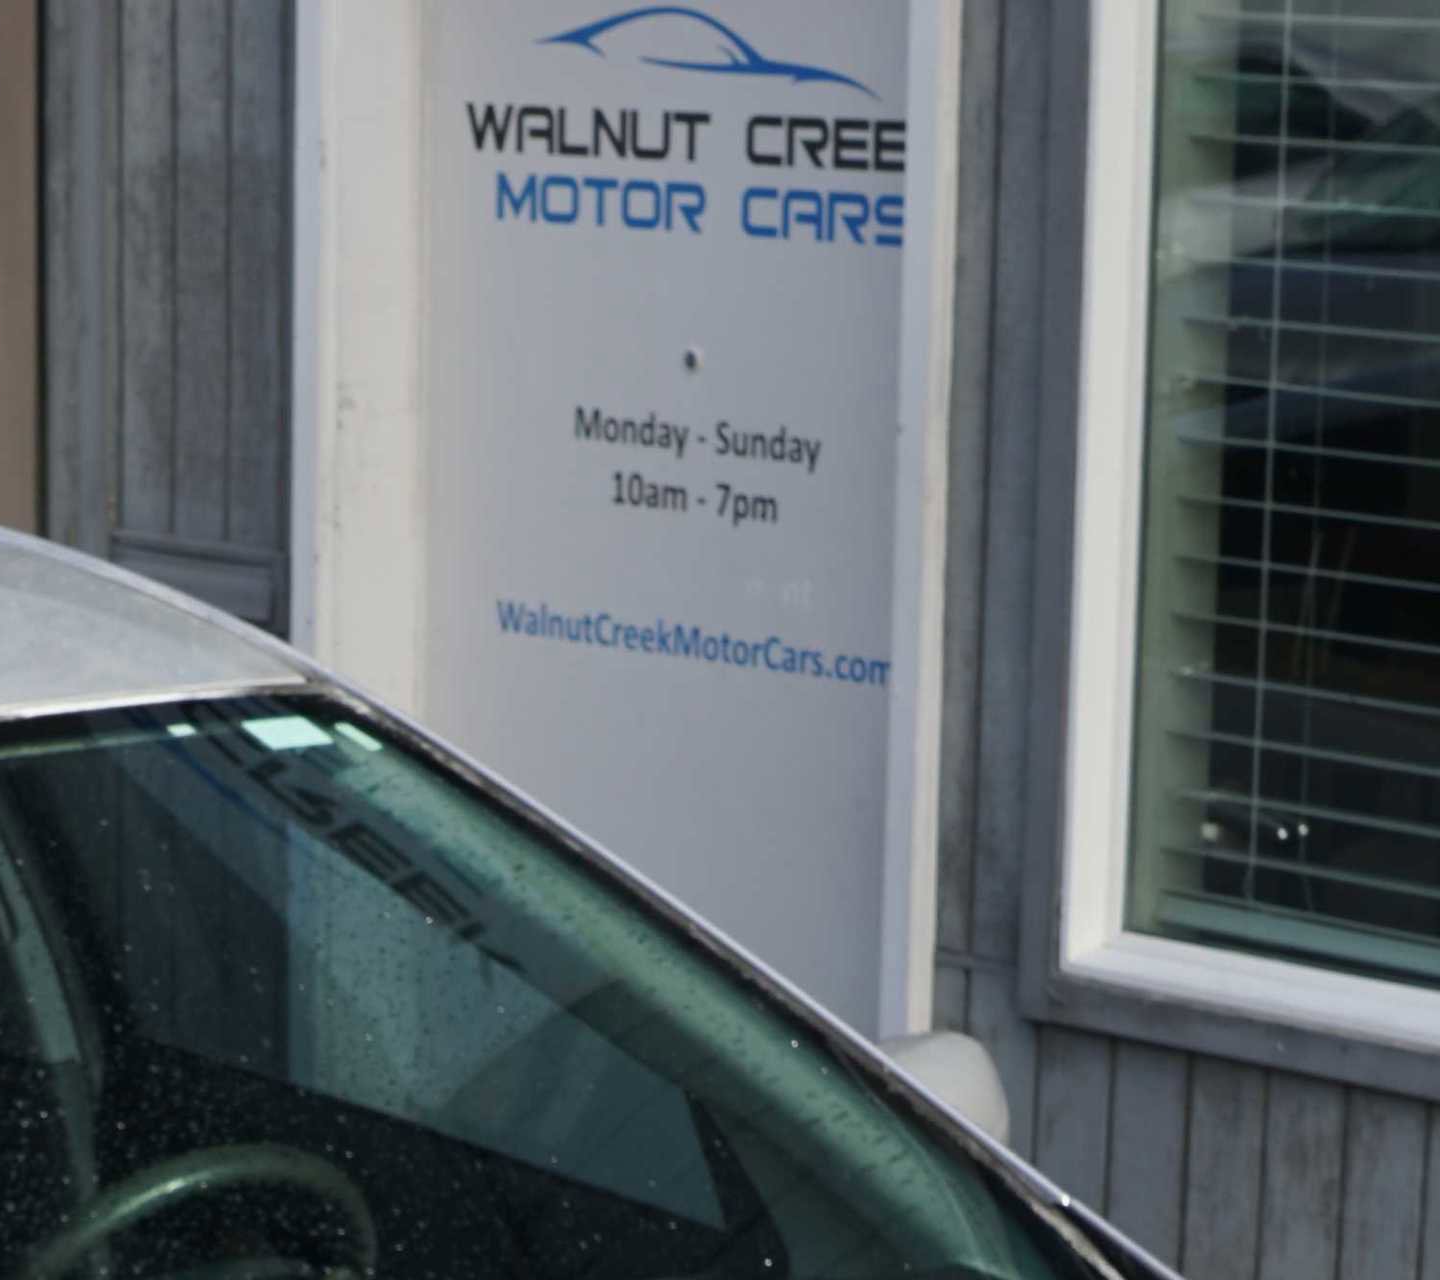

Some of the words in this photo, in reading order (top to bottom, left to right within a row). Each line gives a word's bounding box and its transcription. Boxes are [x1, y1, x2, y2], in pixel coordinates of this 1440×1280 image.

[467, 101, 712, 162] WALNUT
[746, 115, 906, 171] CREE
[495, 170, 706, 234] MOTOR
[741, 186, 904, 247] CARS
[574, 404, 689, 459] Monday
[715, 418, 822, 475] Sunday
[613, 469, 688, 512] 10am
[715, 482, 779, 527] 7pm
[496, 599, 890, 687] WalnutCreekMotorCars.com
